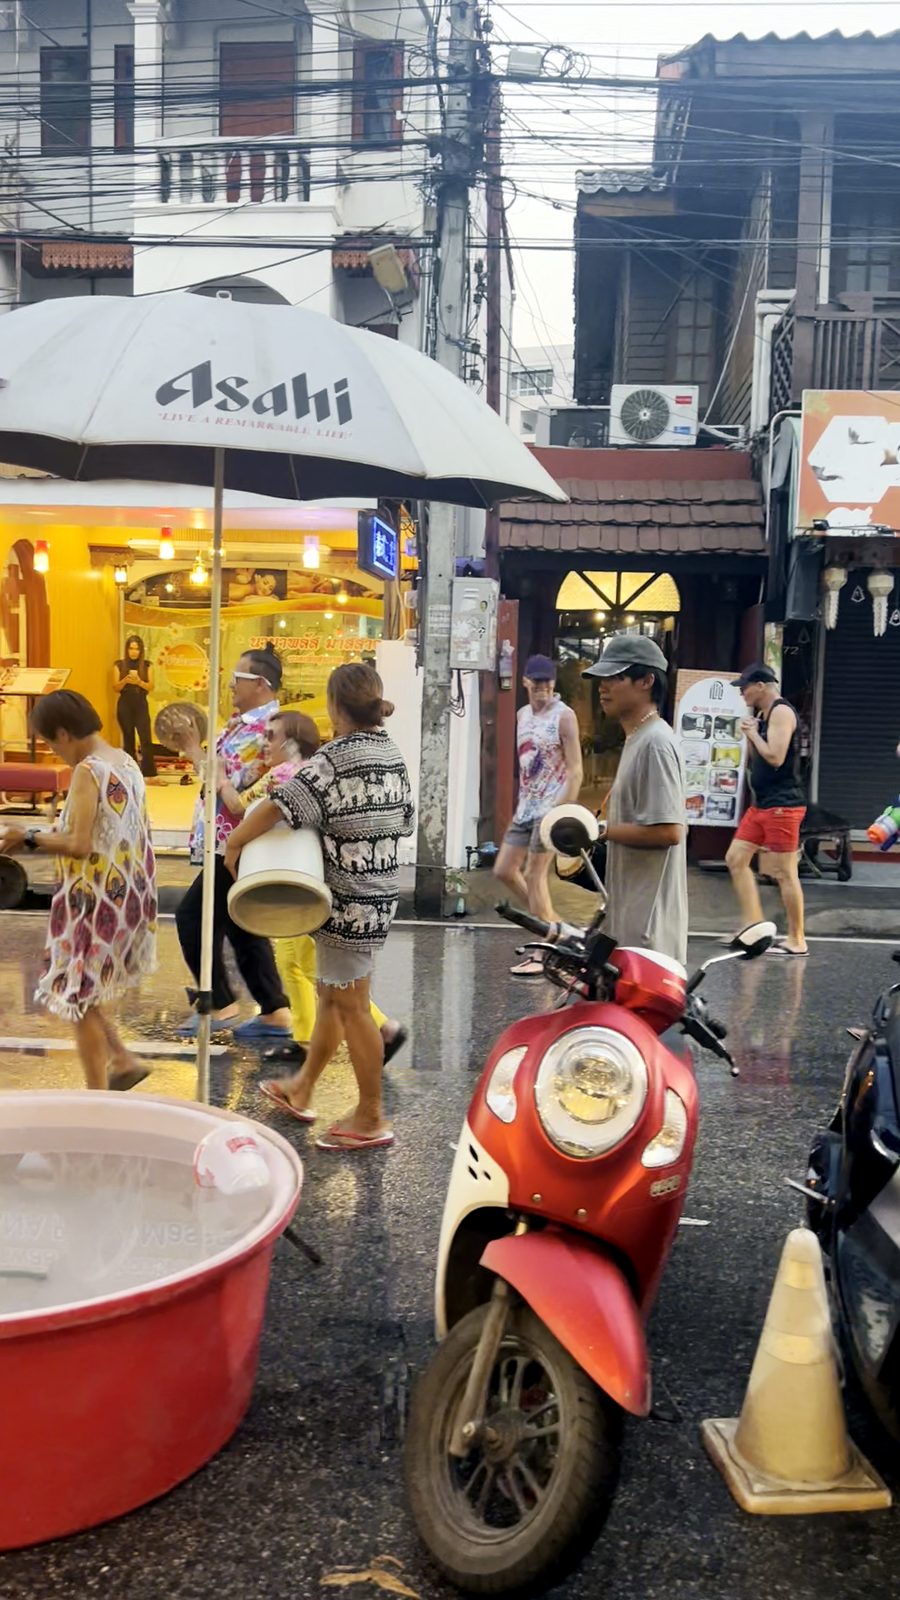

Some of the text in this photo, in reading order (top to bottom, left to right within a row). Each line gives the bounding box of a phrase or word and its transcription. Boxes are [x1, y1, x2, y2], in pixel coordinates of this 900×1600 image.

[155, 360, 352, 425] Asahi
[200, 415, 209, 424] A
[214, 417, 311, 436] REMARKABLE
